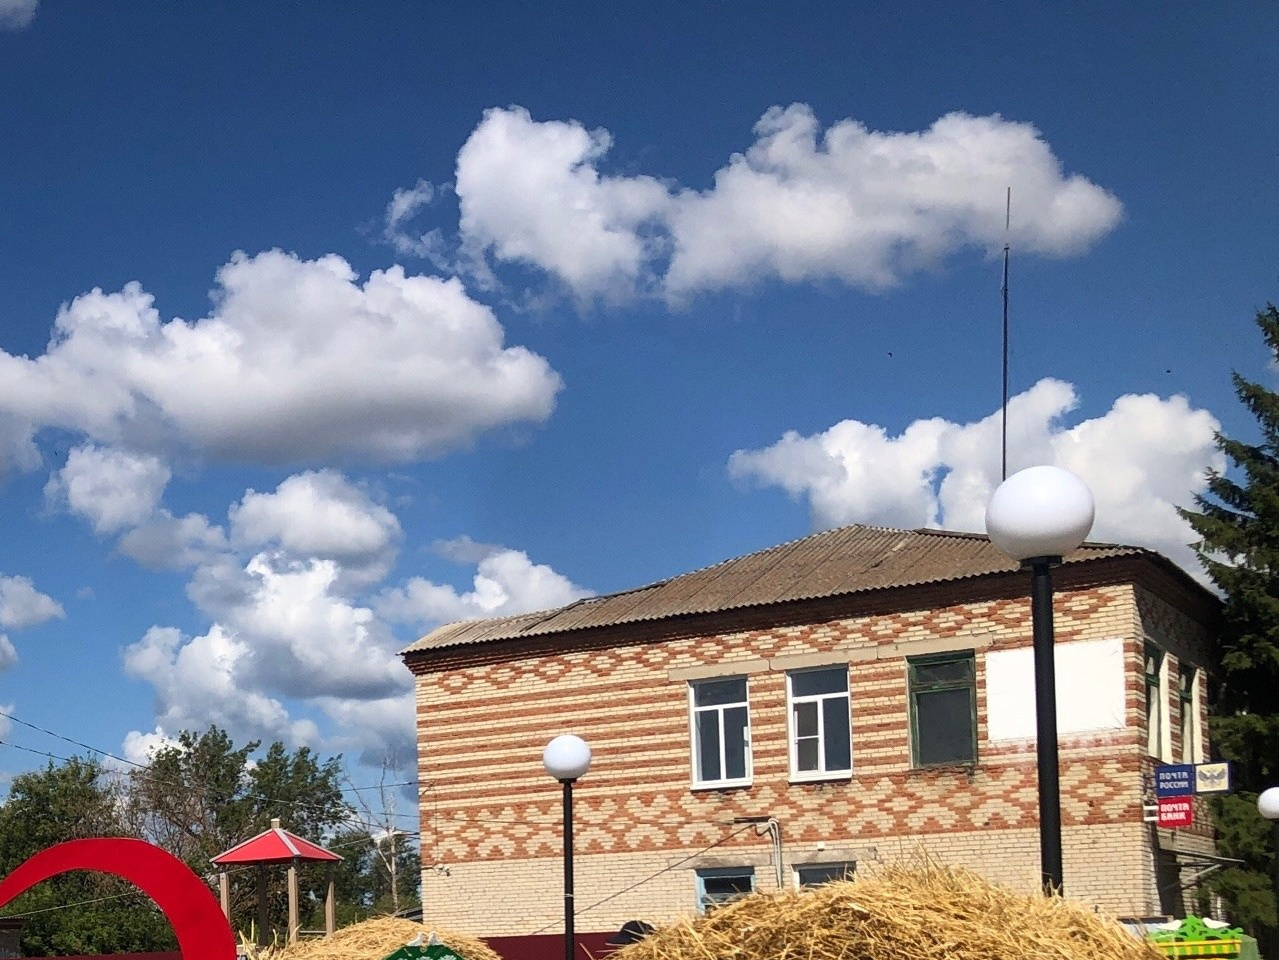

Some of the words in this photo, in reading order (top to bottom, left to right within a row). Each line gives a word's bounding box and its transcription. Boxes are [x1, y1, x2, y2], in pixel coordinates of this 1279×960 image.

[1159, 772, 1188, 780] ПОЧТА
[1159, 781, 1188, 789] РОССИИ
[1160, 803, 1189, 812] ПОЧТА
[1160, 812, 1186, 820] БАНК
